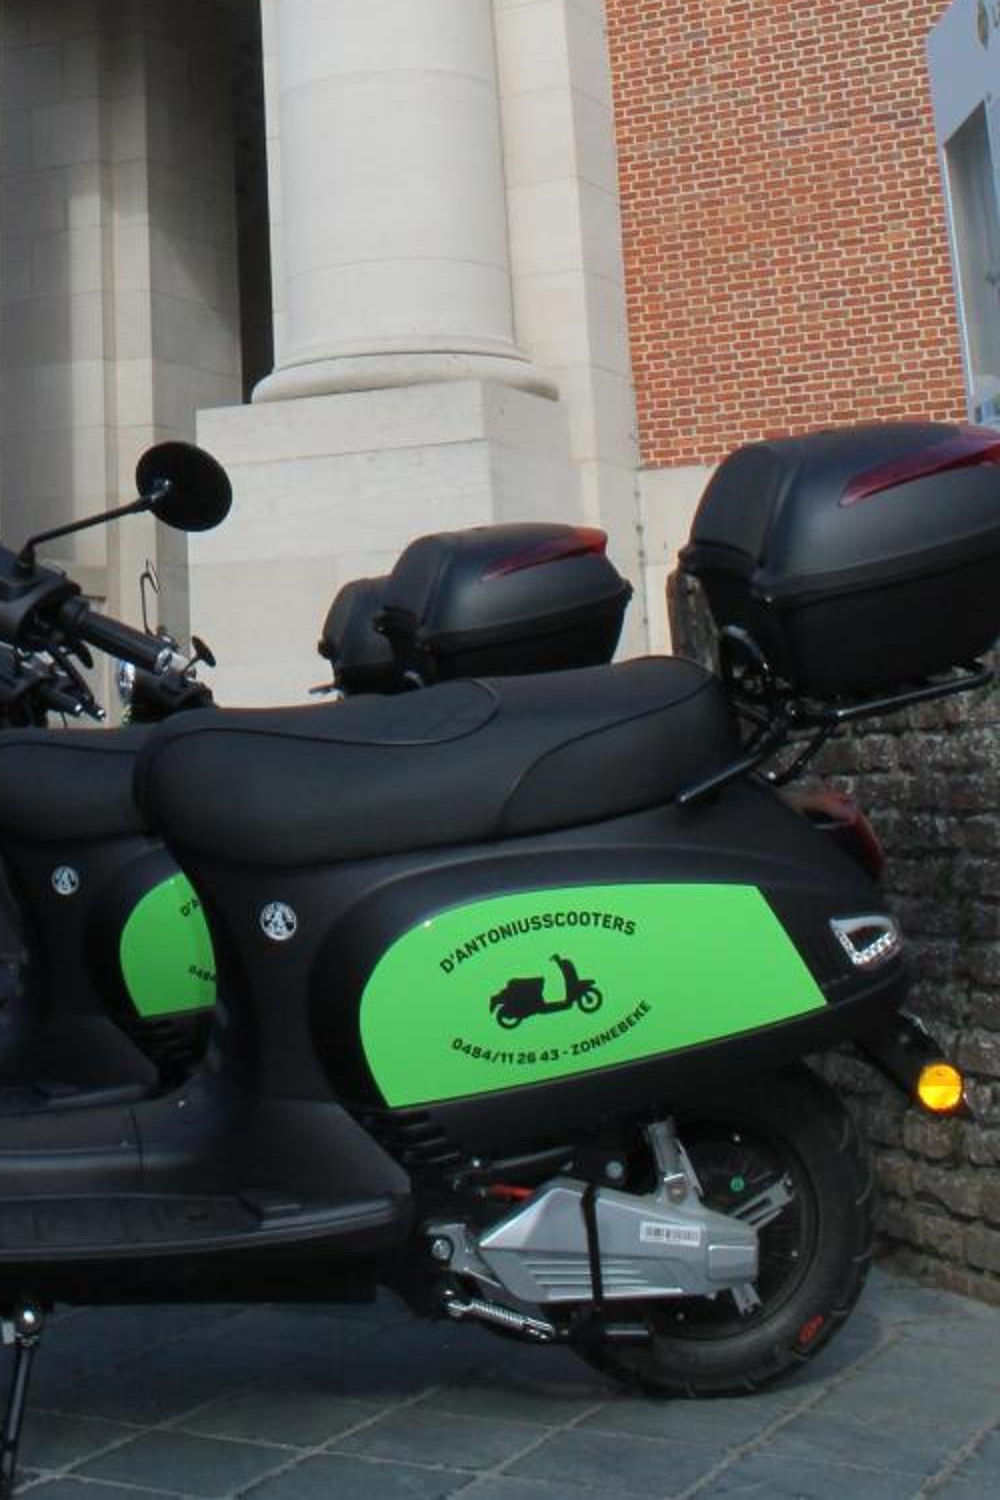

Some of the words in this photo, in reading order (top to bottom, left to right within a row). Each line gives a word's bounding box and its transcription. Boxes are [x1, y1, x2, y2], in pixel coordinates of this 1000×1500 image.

[439, 911, 636, 974] D'ANTONIUSSCOOTERS
[540, 1049, 559, 1061] 43
[571, 1000, 651, 1055] ZONNEBEKE
